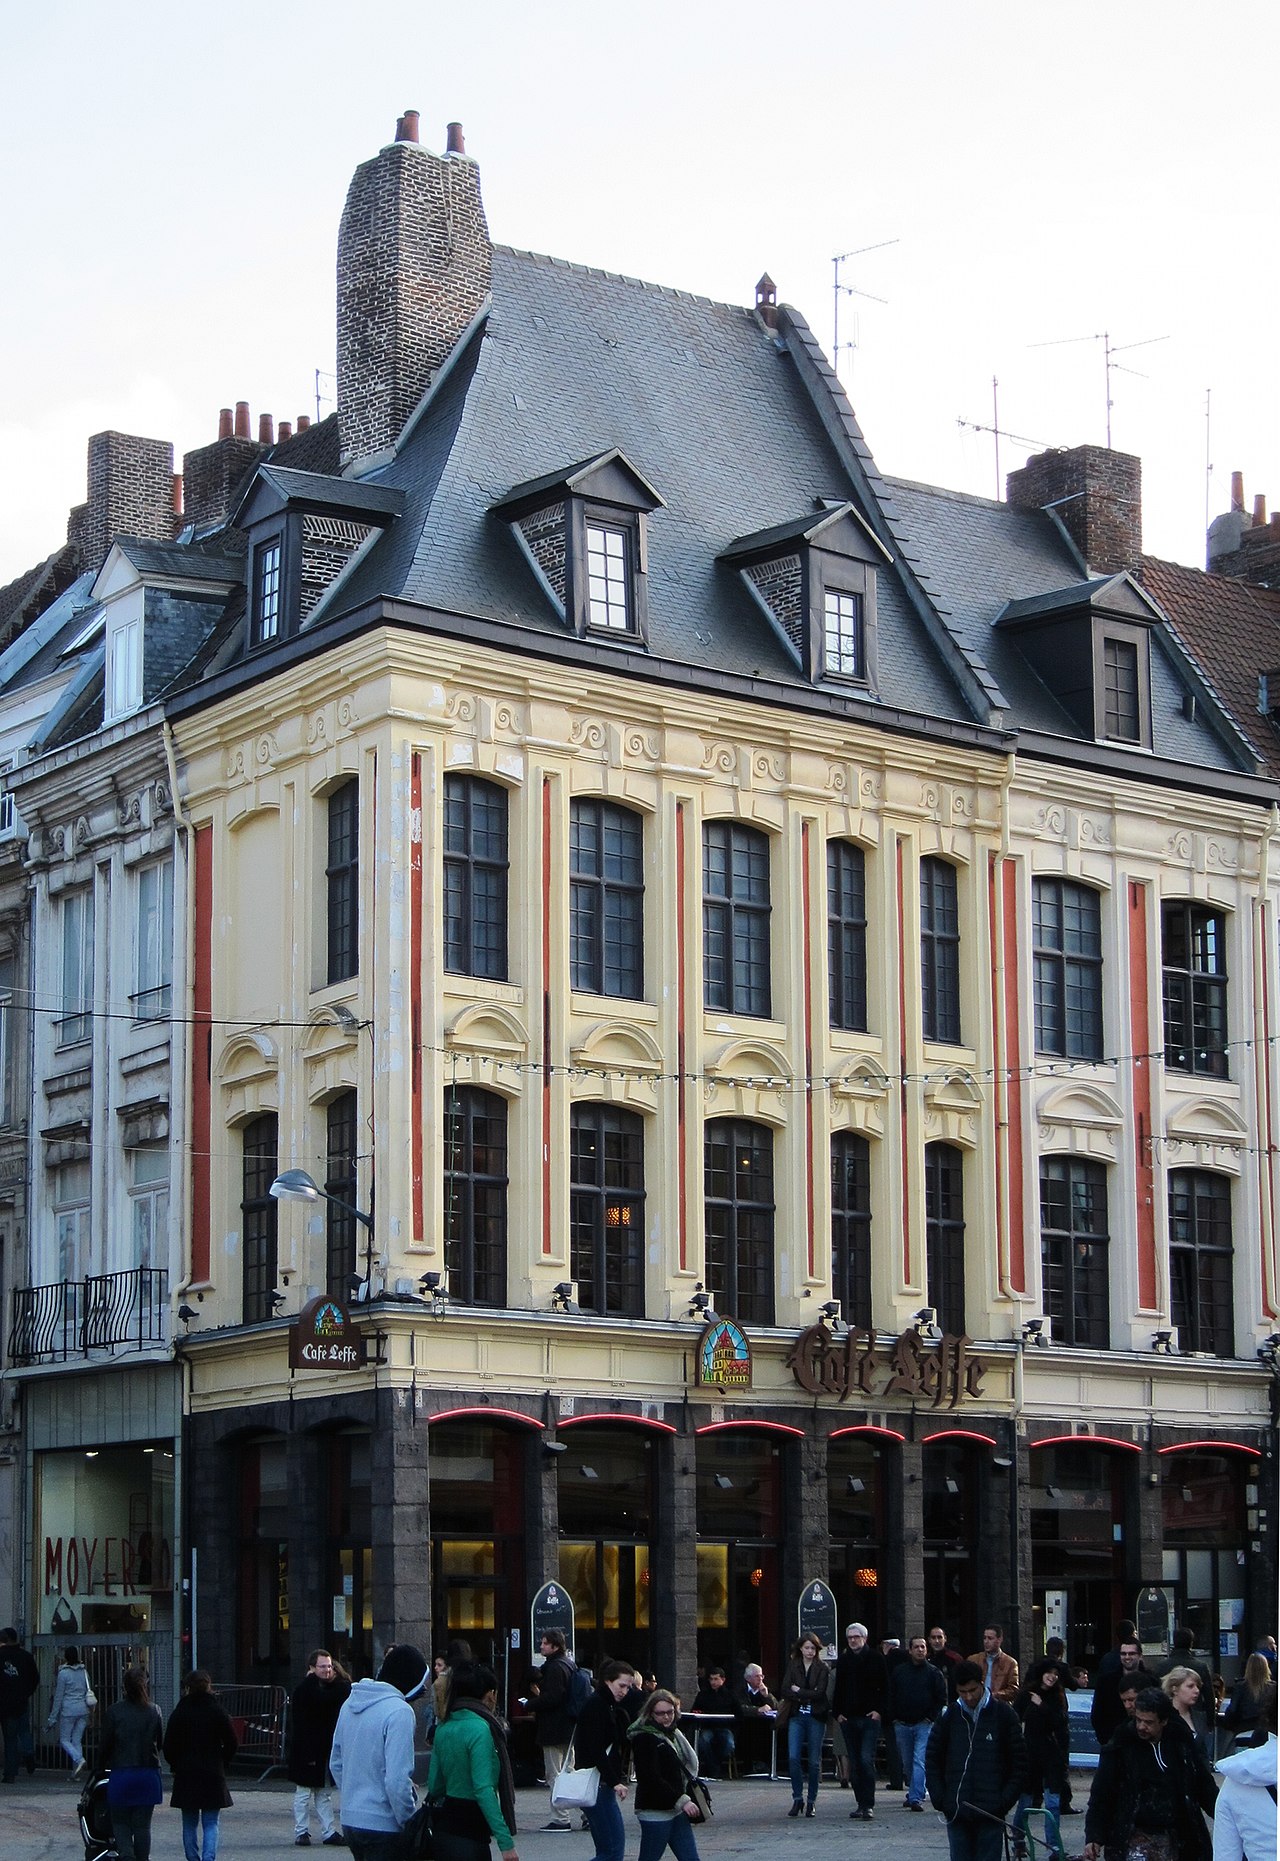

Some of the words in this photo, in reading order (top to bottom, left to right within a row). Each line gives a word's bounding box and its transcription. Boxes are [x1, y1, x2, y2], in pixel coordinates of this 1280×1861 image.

[302, 1343, 327, 1361] Café
[329, 1344, 357, 1363] Leffe
[786, 1323, 879, 1402] Café
[883, 1328, 988, 1408] Leffe
